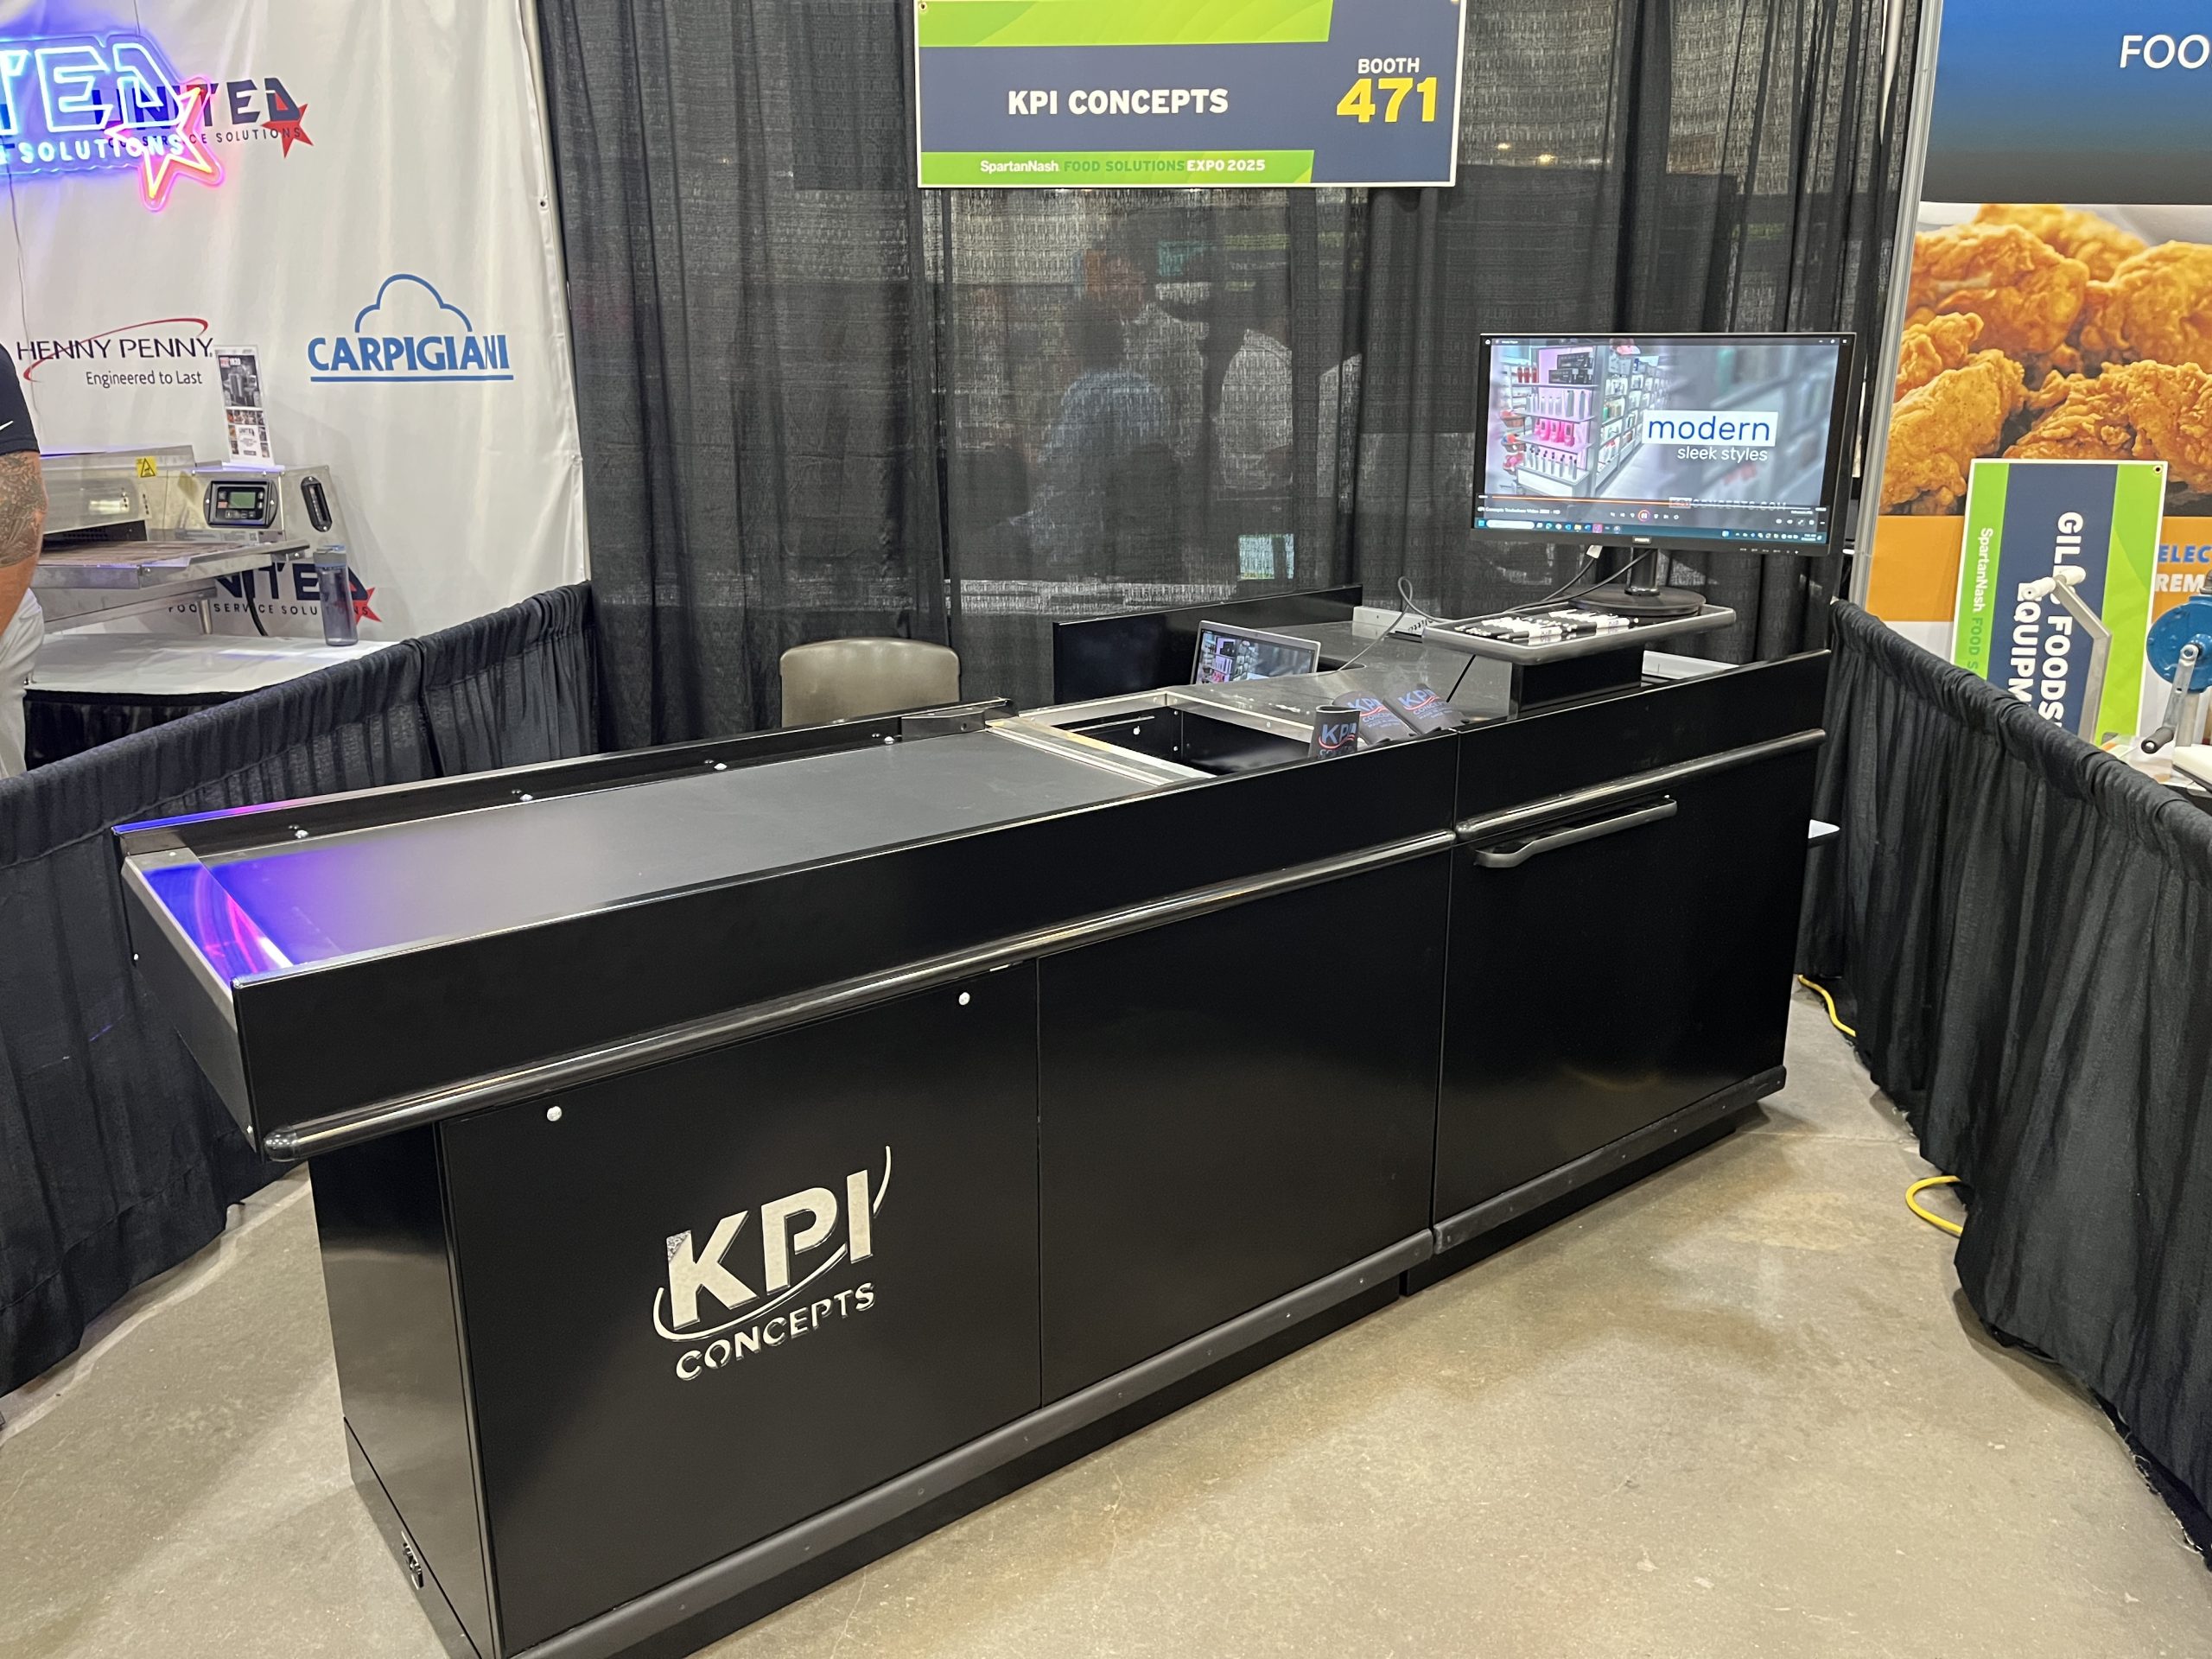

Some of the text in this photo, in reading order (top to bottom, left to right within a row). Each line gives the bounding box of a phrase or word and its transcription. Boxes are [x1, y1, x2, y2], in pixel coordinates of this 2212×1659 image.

[1358, 58, 1420, 74] BOOTH
[2120, 34, 2210, 69] FOO
[1007, 88, 1229, 115] KPI CONCEPTS
[1336, 77, 1438, 123] 471
[19, 131, 185, 164] SOLUTIONS
[216, 127, 302, 143] SOLUTIONS
[980, 159, 1266, 174] SpartanNash FOOD SOLUTIONS EXPO 2025
[16, 337, 213, 360] HENNY PENNY
[308, 334, 510, 372] CARPIGIANI
[86, 370, 203, 389] Engineered to Last
[1648, 415, 1770, 442] modern
[1677, 446, 1768, 464] sleek styles
[1973, 527, 1994, 613] SpartanNash
[2050, 511, 2084, 605] GIL
[213, 603, 275, 614] SERVCE
[281, 606, 368, 616] SOLUNS
[1969, 617, 1983, 656] FOOD
[2037, 615, 2074, 728] FOODS
[666, 1169, 873, 1331] KPI
[676, 1282, 875, 1381] CONCEPTS
